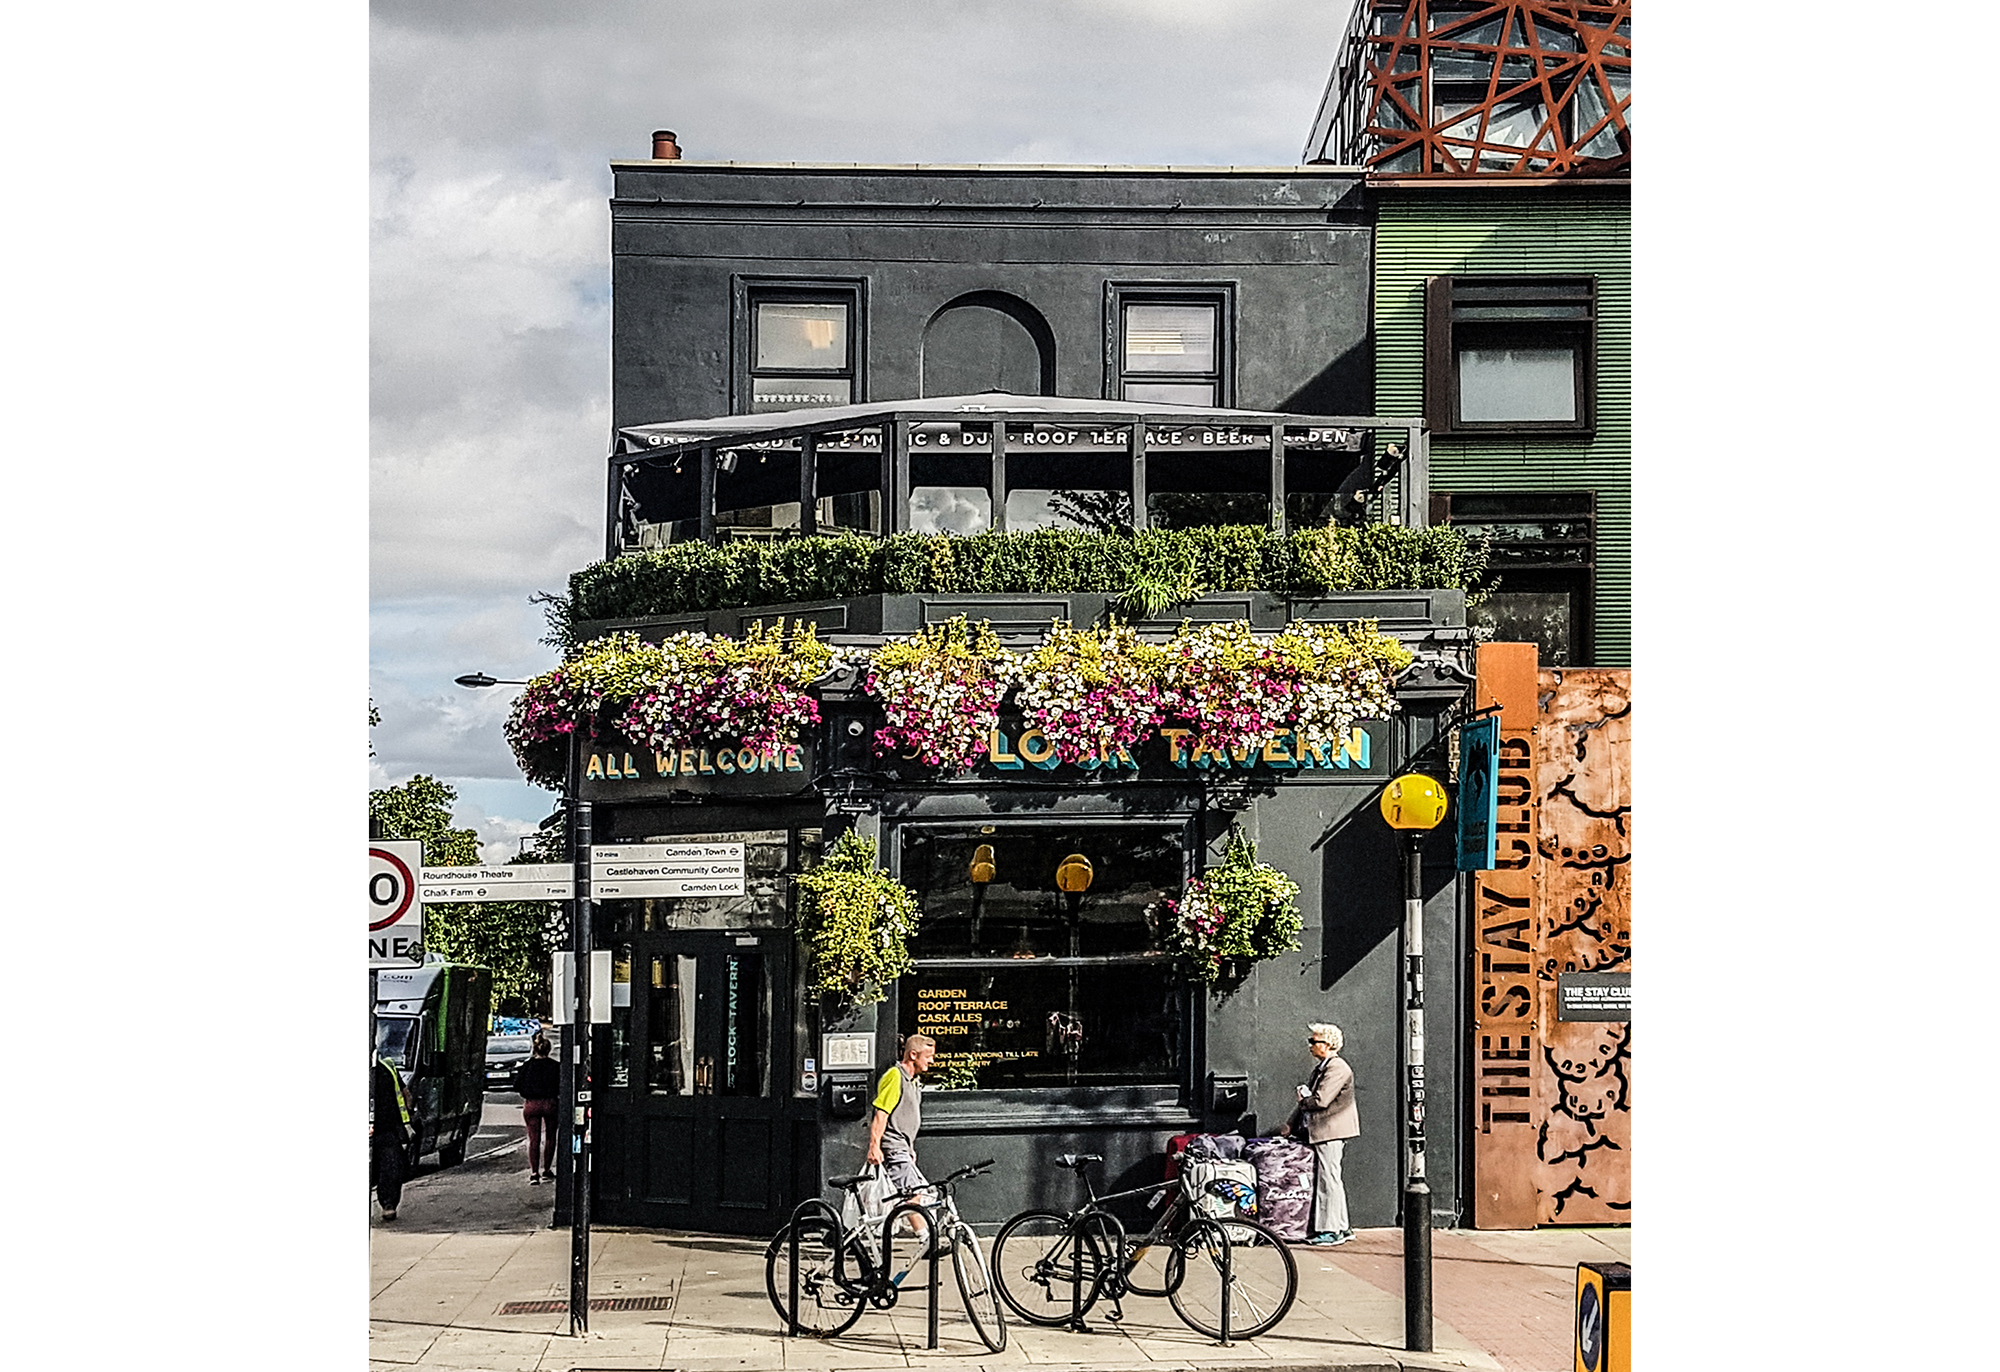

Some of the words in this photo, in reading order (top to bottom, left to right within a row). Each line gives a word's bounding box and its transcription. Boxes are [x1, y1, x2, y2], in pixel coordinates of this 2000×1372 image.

[863, 433, 928, 446] MIC
[939, 433, 951, 445] &
[1023, 432, 1079, 445] ROOF
[1090, 431, 1182, 444] TERACE
[989, 728, 1140, 771] LOK
[586, 753, 640, 780] ALL
[656, 748, 803, 778] WELCOME
[1494, 737, 1531, 871] CLUB
[666, 848, 702, 857] Camden
[704, 848, 727, 856] Town
[423, 872, 477, 880] Roundhouse
[480, 870, 513, 878] Theatre
[606, 867, 660, 876] Castlehaven
[661, 866, 709, 875] Community
[711, 865, 740, 874] Centre
[423, 889, 449, 897] Chalk
[450, 888, 474, 896] Farm
[681, 883, 717, 892] Camden
[719, 882, 740, 891] Lock
[1481, 885, 1531, 1018] STAY
[729, 960, 739, 1018] TAVERN
[917, 989, 967, 999] GARDEN
[1564, 986, 1584, 997] THE
[1584, 986, 1610, 997] STAY
[917, 1001, 951, 1011] ROOF
[953, 1000, 1008, 1010] TERRACE
[917, 1013, 951, 1023] CASK
[952, 1013, 983, 1023] ALES
[917, 1025, 969, 1035] KITCHEN
[727, 1026, 738, 1066] LOCK
[1481, 1036, 1531, 1134] THE
